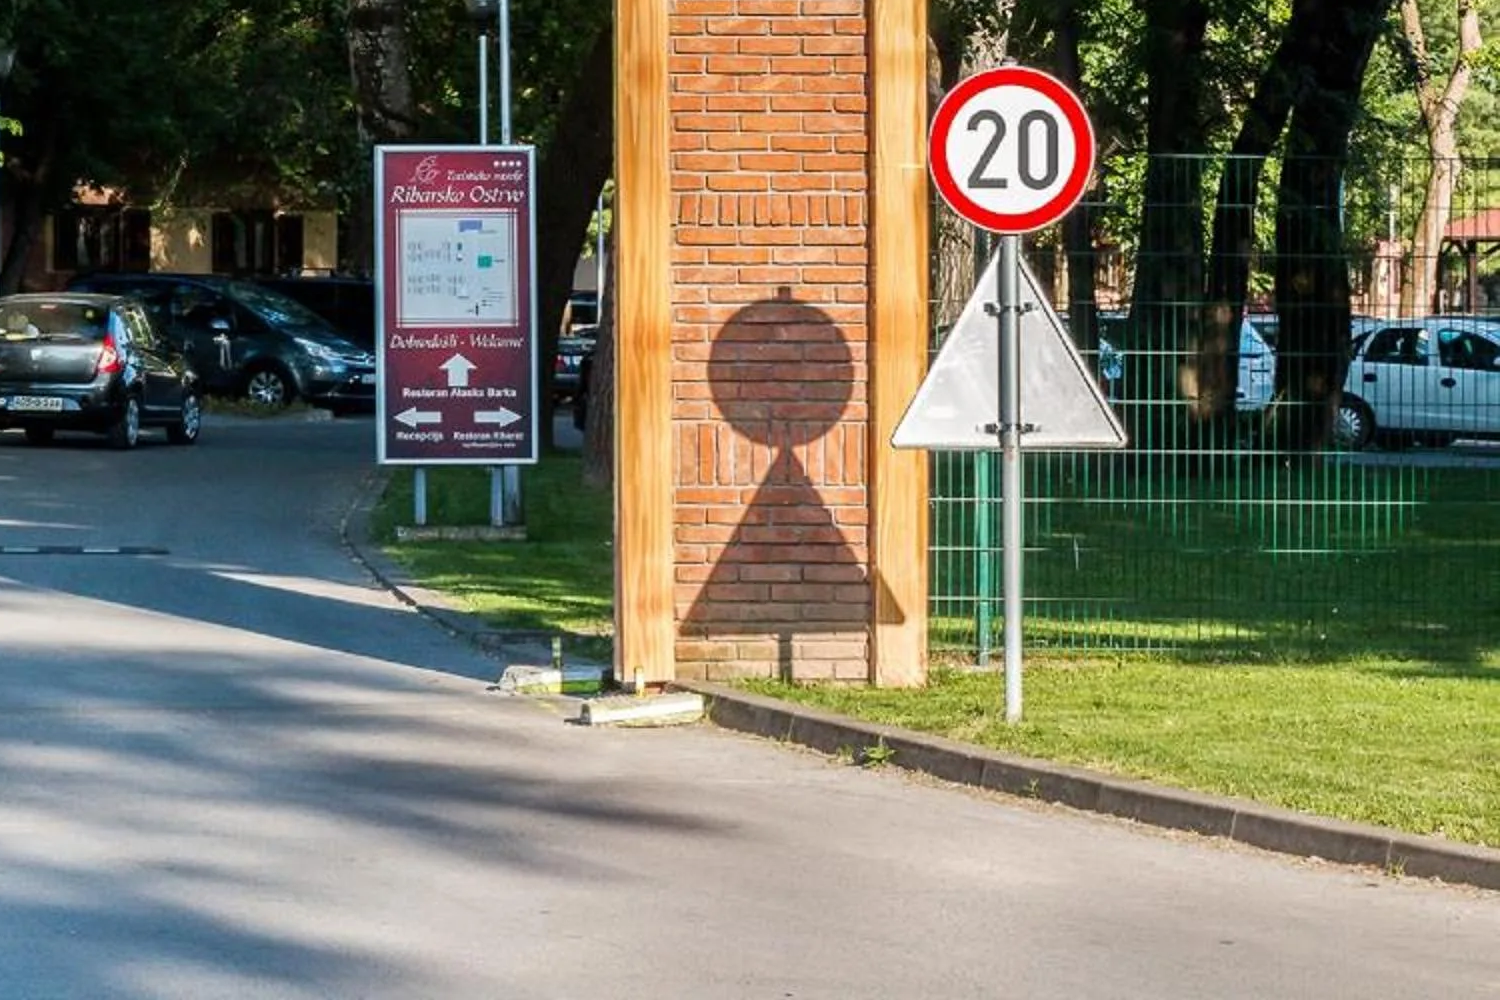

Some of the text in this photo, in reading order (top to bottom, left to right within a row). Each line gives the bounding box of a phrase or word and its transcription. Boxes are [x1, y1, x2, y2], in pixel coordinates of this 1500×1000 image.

[967, 109, 1059, 190] 20
[391, 185, 525, 203] Ribarsko Ostrvo
[402, 387, 448, 398] Restoran
